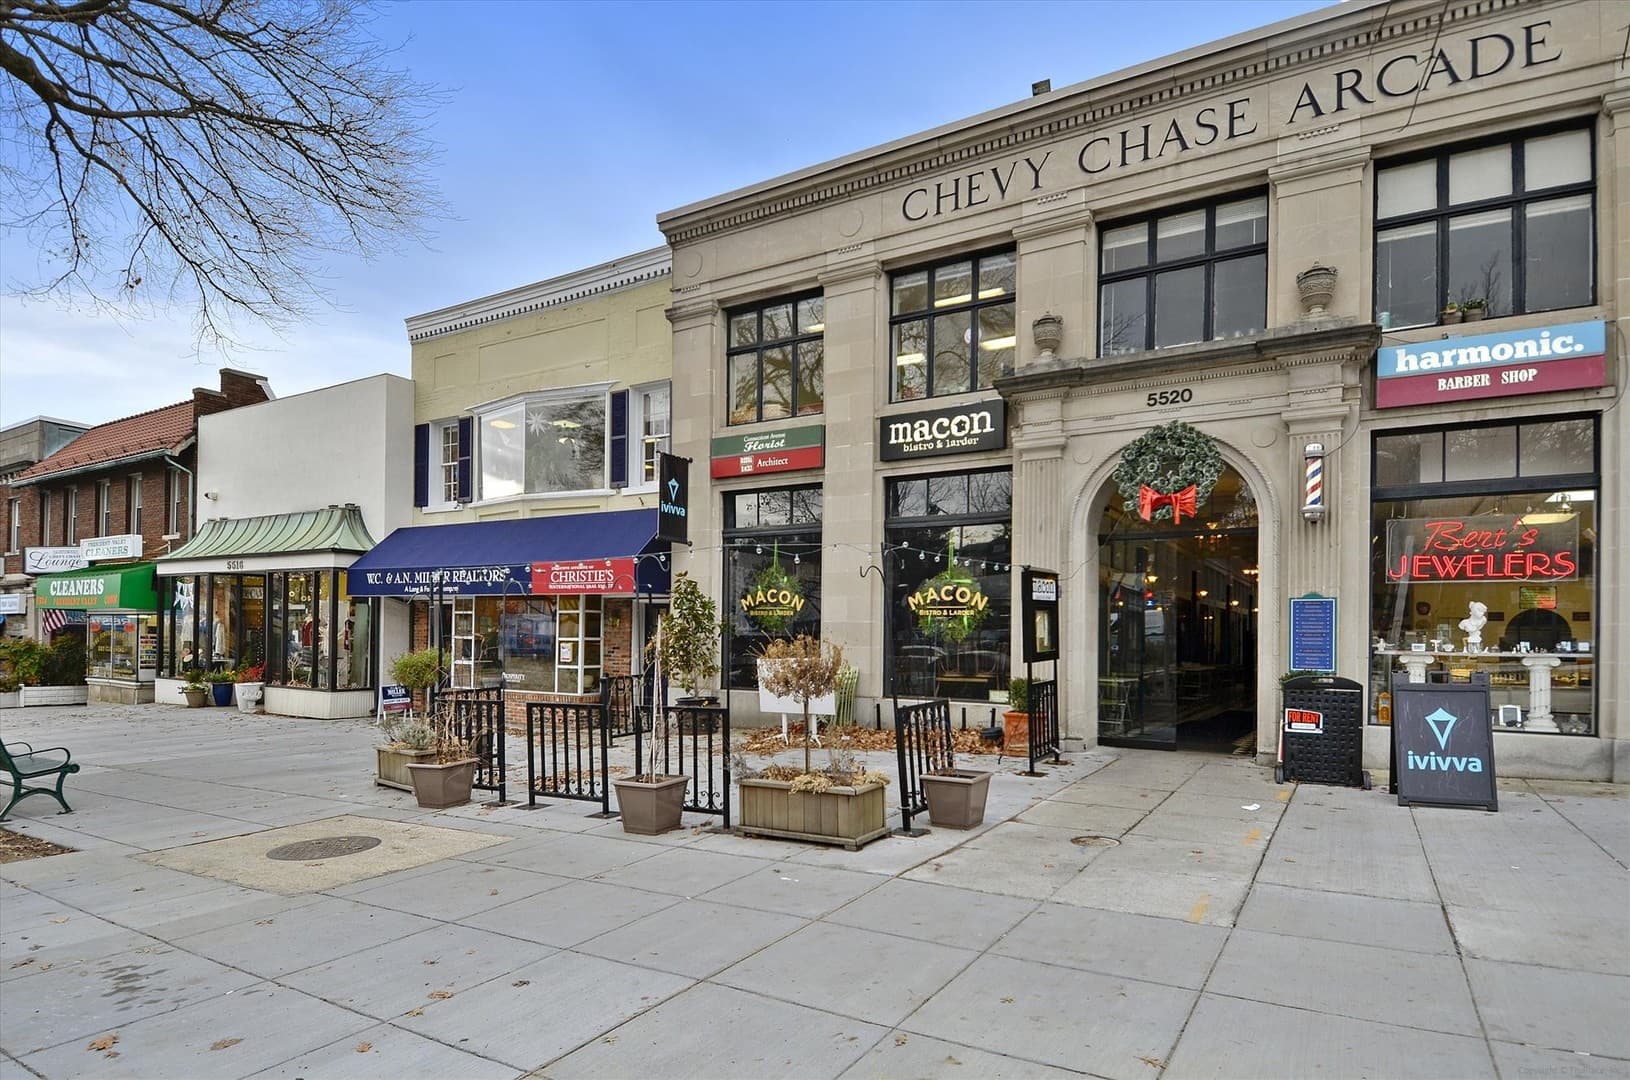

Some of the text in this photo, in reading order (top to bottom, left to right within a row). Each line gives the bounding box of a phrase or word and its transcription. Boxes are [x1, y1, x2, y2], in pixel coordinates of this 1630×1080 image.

[902, 20, 1563, 221] CHEVY CHASE ARCADE
[1395, 331, 1585, 373] harmonic.
[1438, 368, 1538, 391] BARBER SHOP
[1146, 388, 1193, 407] 5520
[889, 411, 995, 444] macon
[744, 439, 785, 452] Florist
[903, 437, 979, 452] bistro & larder
[757, 457, 788, 467] Architect
[661, 500, 686, 517] ivivva
[1425, 516, 1539, 551] Bert's
[29, 551, 81, 570] Lounge
[86, 546, 129, 557] CLEANERS
[1389, 552, 1576, 580] JEWELERS
[386, 572, 393, 585] &
[453, 568, 506, 583] REALTORS
[550, 569, 614, 583] CHRISTIE'S
[50, 579, 104, 596] CLEANERS
[741, 589, 805, 611] MACON
[908, 586, 989, 611] MACON
[1289, 711, 1319, 724] FOR RENT
[1408, 750, 1483, 773] ivivva
